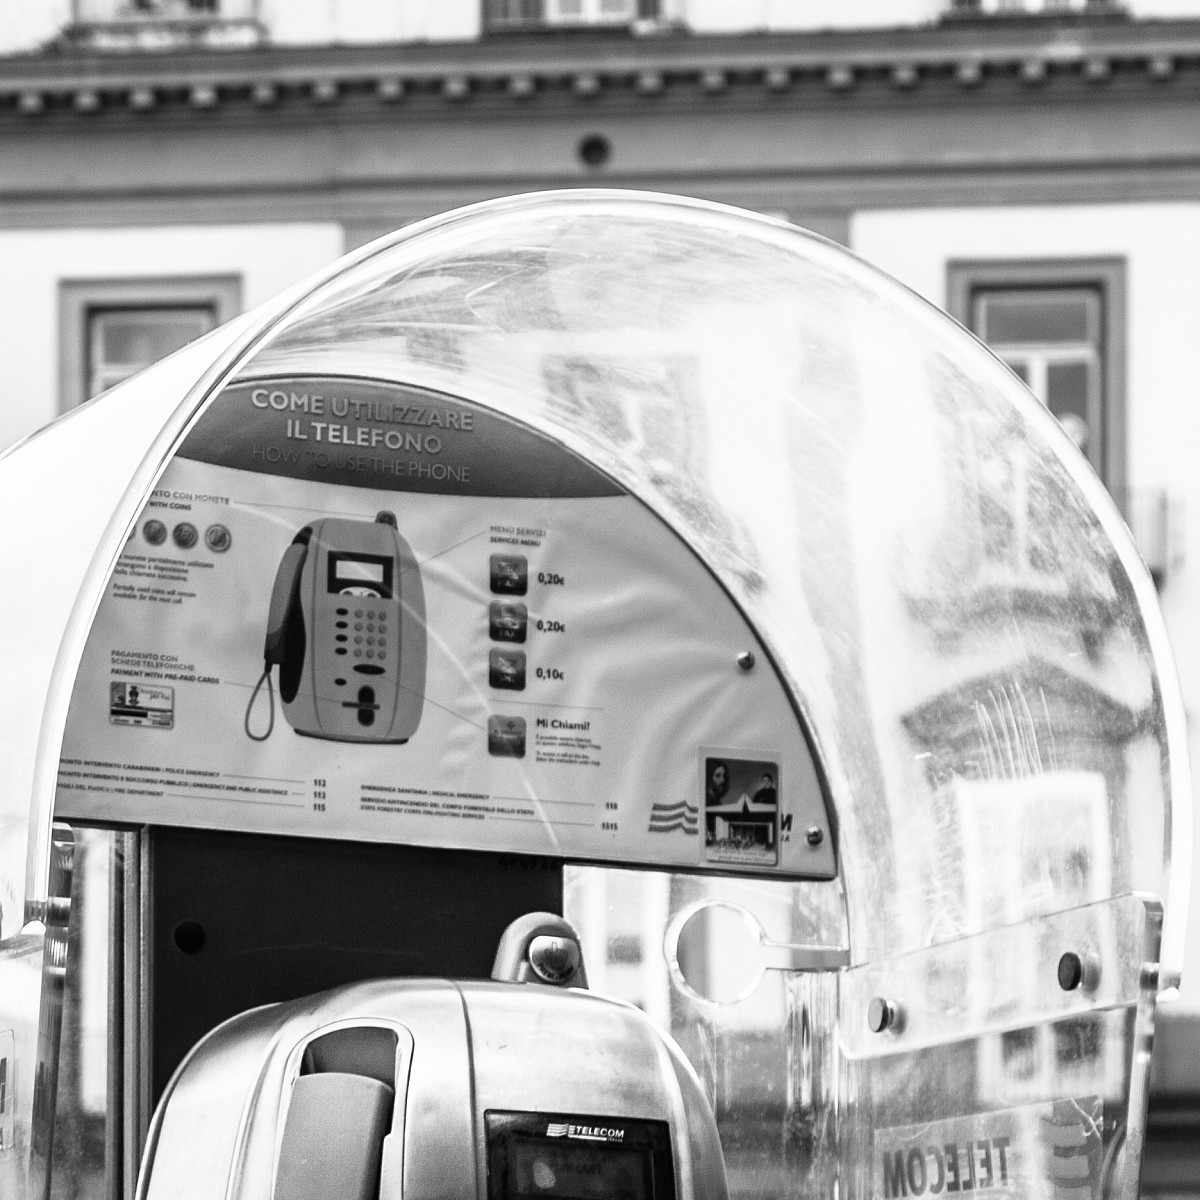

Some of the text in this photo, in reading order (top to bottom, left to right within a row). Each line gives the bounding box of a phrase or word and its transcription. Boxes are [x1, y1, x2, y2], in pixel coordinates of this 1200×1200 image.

[251, 388, 474, 431] COME UTILIZZARE
[287, 418, 442, 454] IL TELEFONO
[252, 445, 471, 483] HOW TO USE THE PHONE
[538, 572, 565, 587] 0,20€
[536, 619, 566, 634] 0,20€
[110, 649, 159, 661] PAGAMENTO
[536, 667, 565, 682] 0,10€
[536, 718, 548, 728] Mi
[576, 1125, 625, 1139] TELECOM
